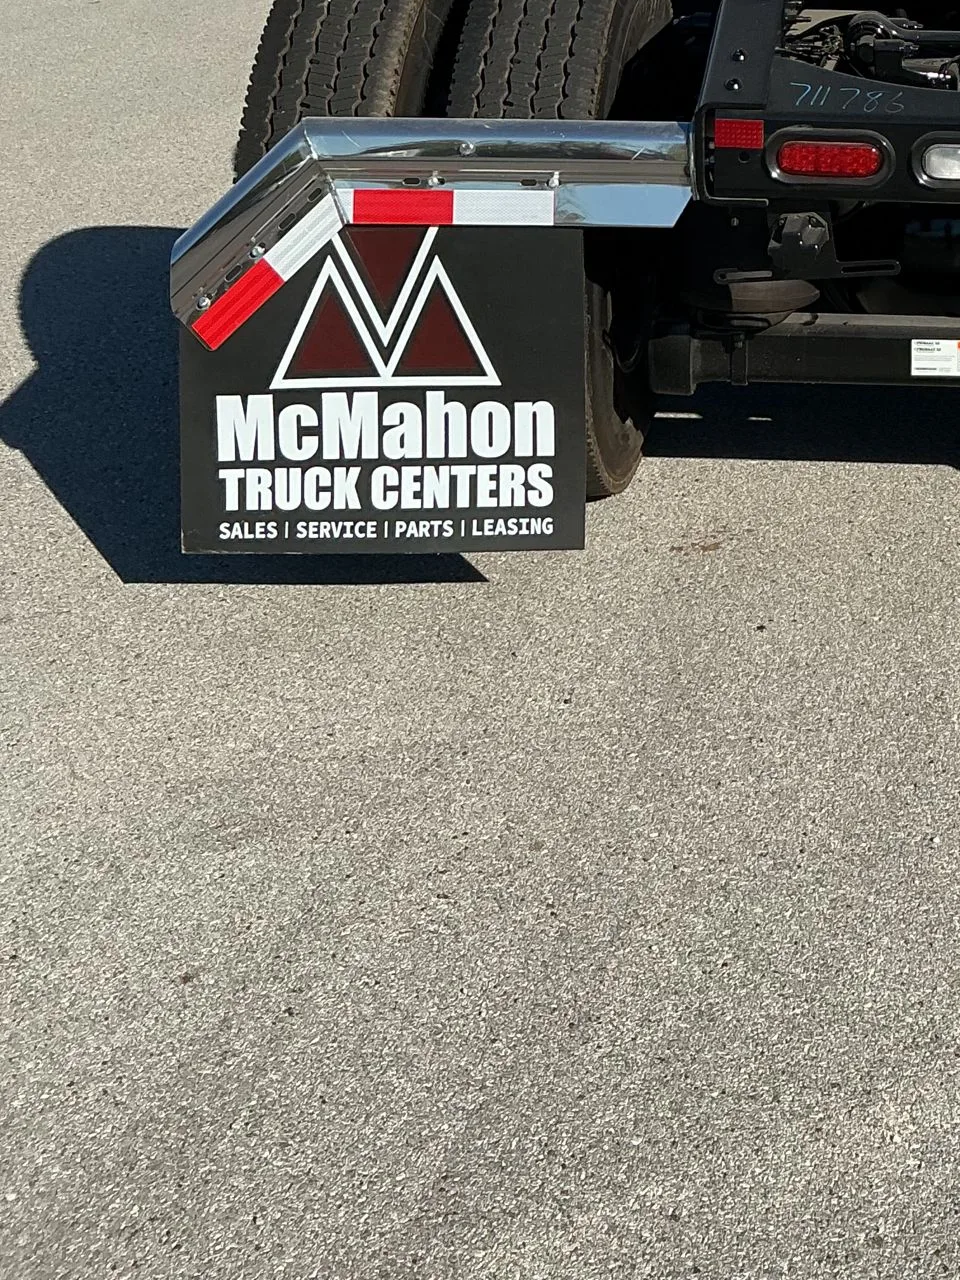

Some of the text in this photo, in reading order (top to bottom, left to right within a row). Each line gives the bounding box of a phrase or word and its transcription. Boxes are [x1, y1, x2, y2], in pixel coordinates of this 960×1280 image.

[215, 390, 555, 462] McMahon
[218, 462, 554, 512] TRUCK CENTERS
[219, 516, 554, 540] SALES SERVICE PARTS LEASING
